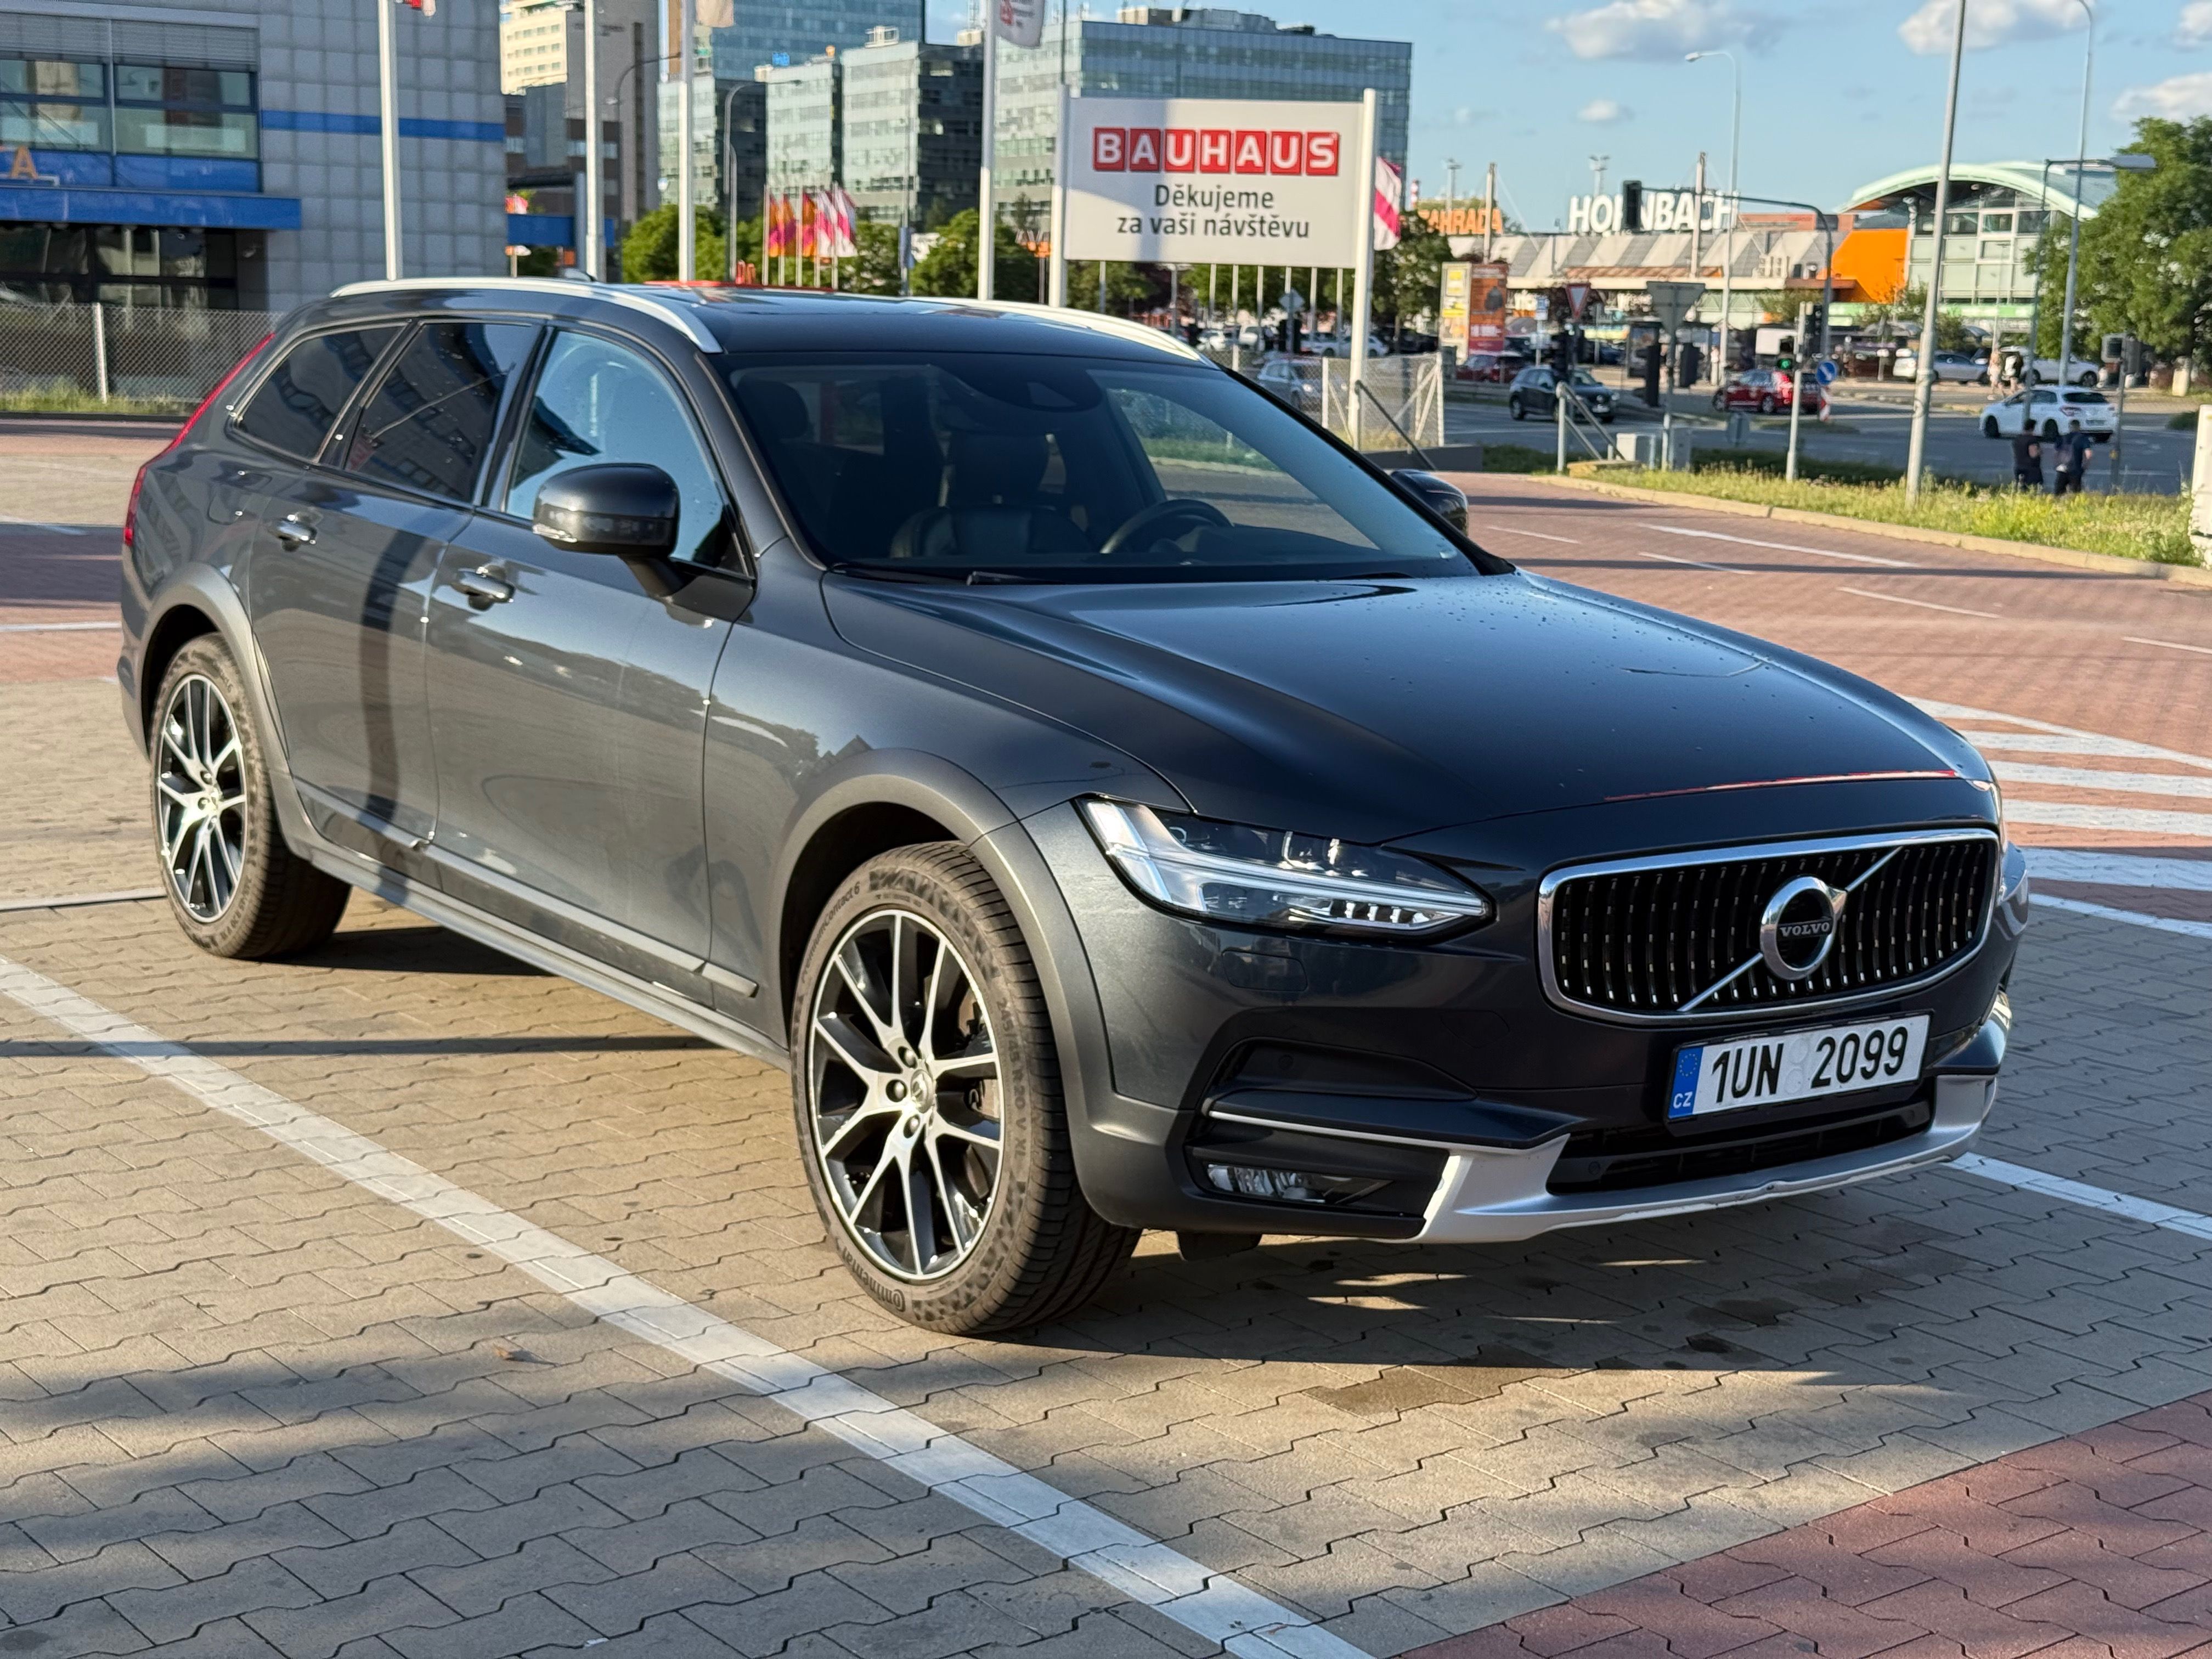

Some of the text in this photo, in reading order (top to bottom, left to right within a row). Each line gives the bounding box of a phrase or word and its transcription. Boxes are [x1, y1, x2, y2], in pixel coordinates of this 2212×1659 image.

[1098, 133, 1336, 169] BAUHAUS
[1155, 184, 1274, 212] Děkujeme
[1117, 212, 1310, 238] za vaši návštěvu
[854, 881, 861, 895] 6
[1780, 922, 1830, 937] VOLVO
[1712, 1026, 1908, 1104] 1UN 2099
[1673, 1091, 1691, 1109] CZ
